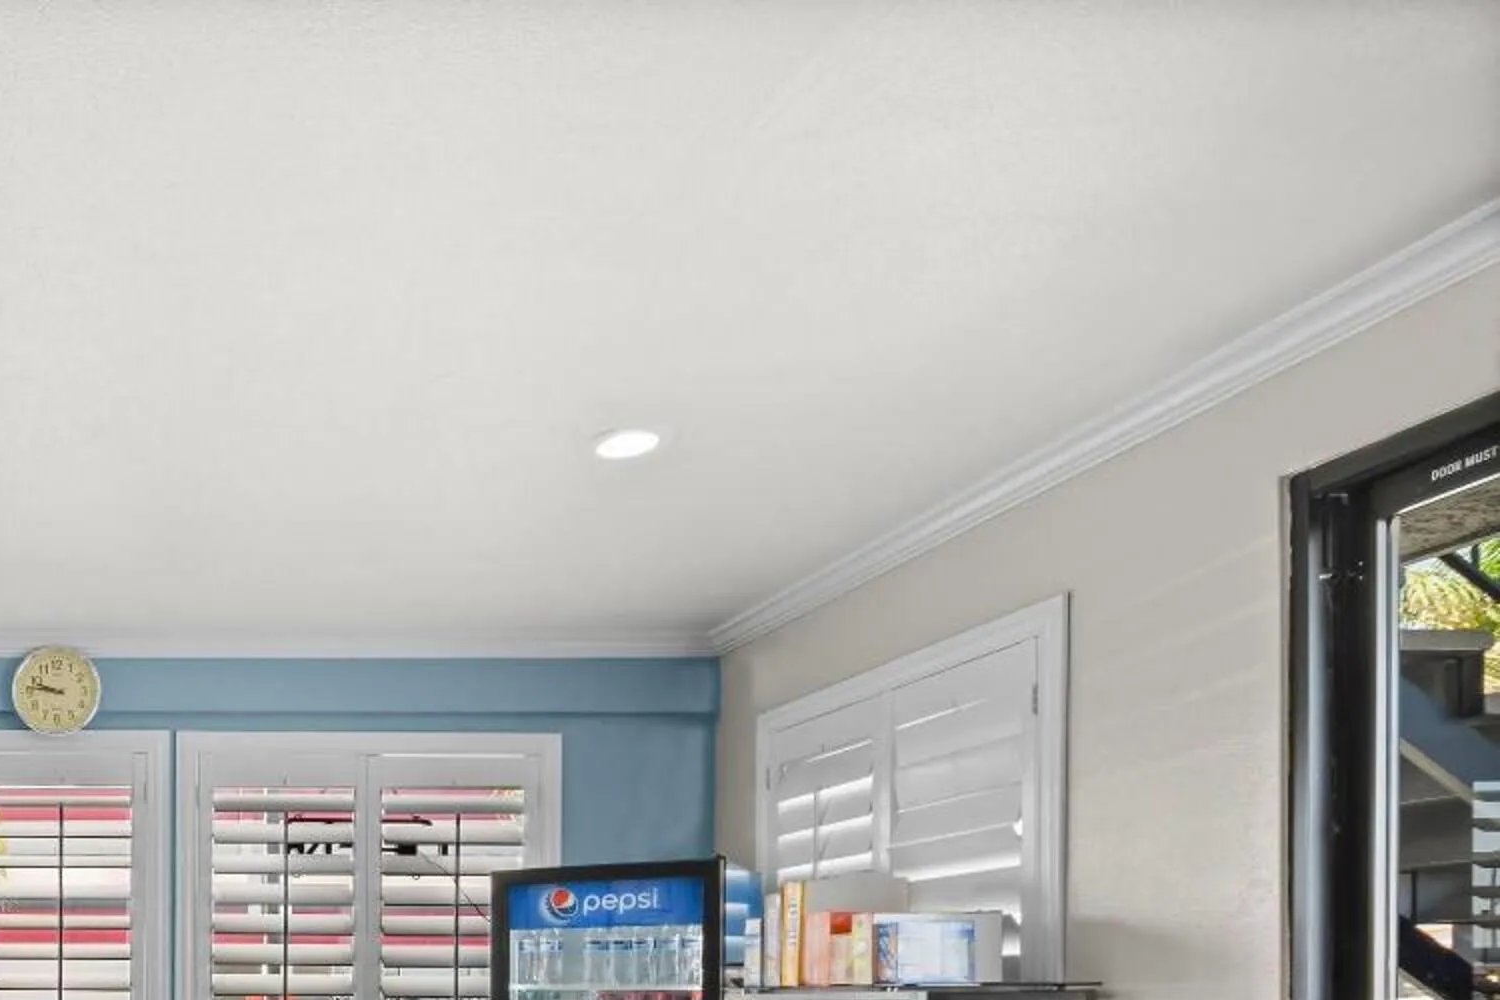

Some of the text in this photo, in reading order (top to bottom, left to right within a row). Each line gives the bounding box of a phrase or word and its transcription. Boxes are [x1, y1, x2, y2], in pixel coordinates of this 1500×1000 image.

[1431, 445, 1500, 481] DOOR MUST
[583, 887, 658, 917] pepsi
